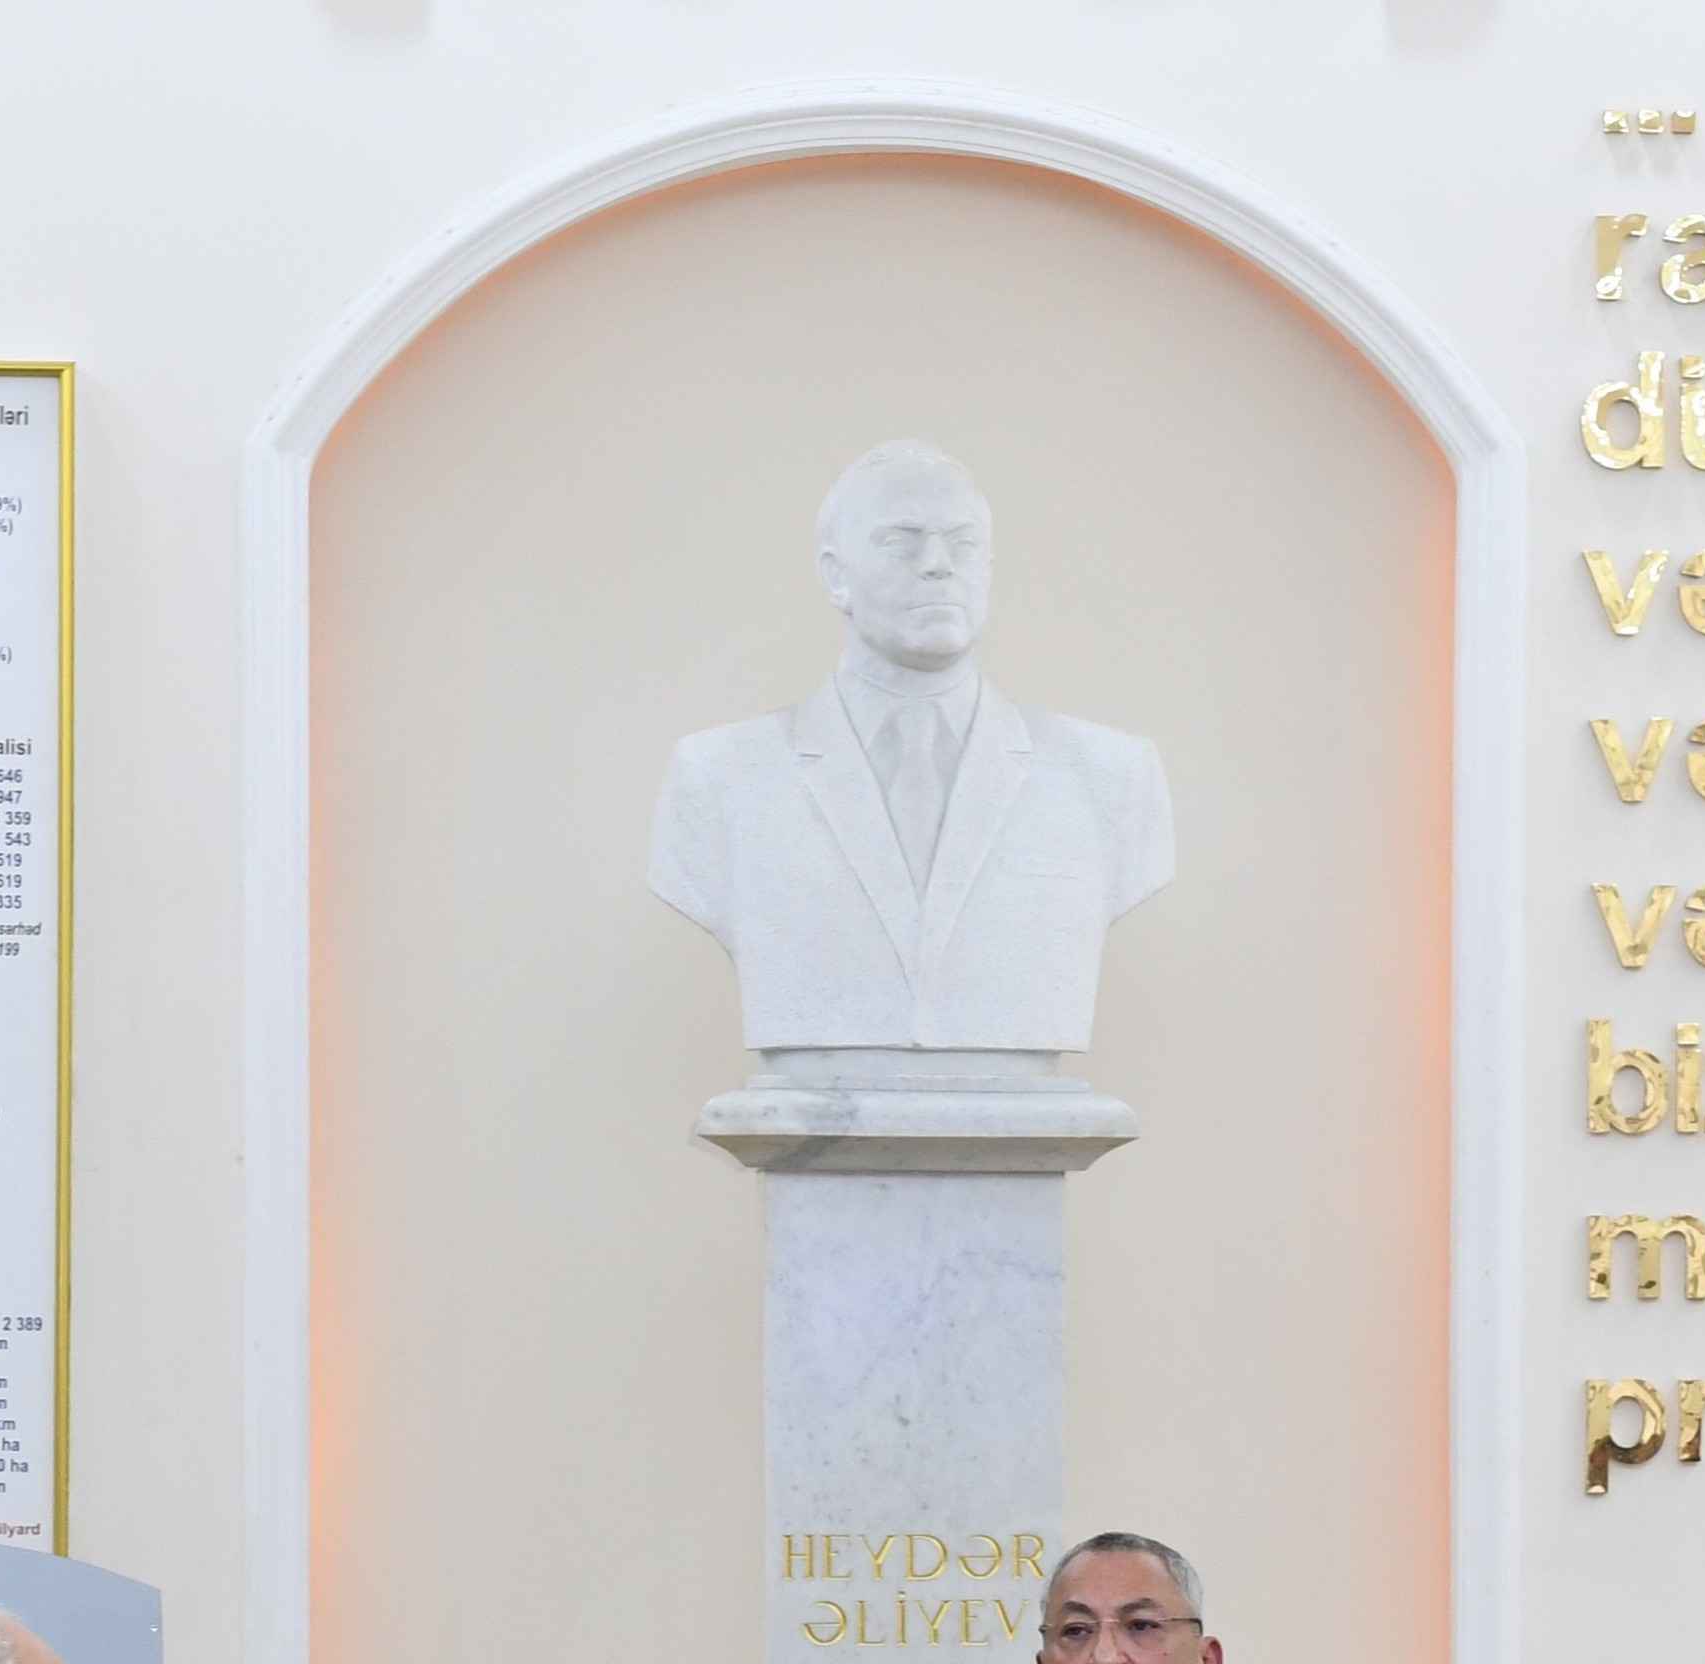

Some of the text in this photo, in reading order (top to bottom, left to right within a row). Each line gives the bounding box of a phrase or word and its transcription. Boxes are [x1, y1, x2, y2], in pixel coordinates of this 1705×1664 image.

[2, 1437, 20, 1451] ha
[10, 1459, 29, 1472] ha
[782, 1534, 1045, 1581] HEYDƏR
[804, 1591, 1028, 1647] ƏLİYEV
